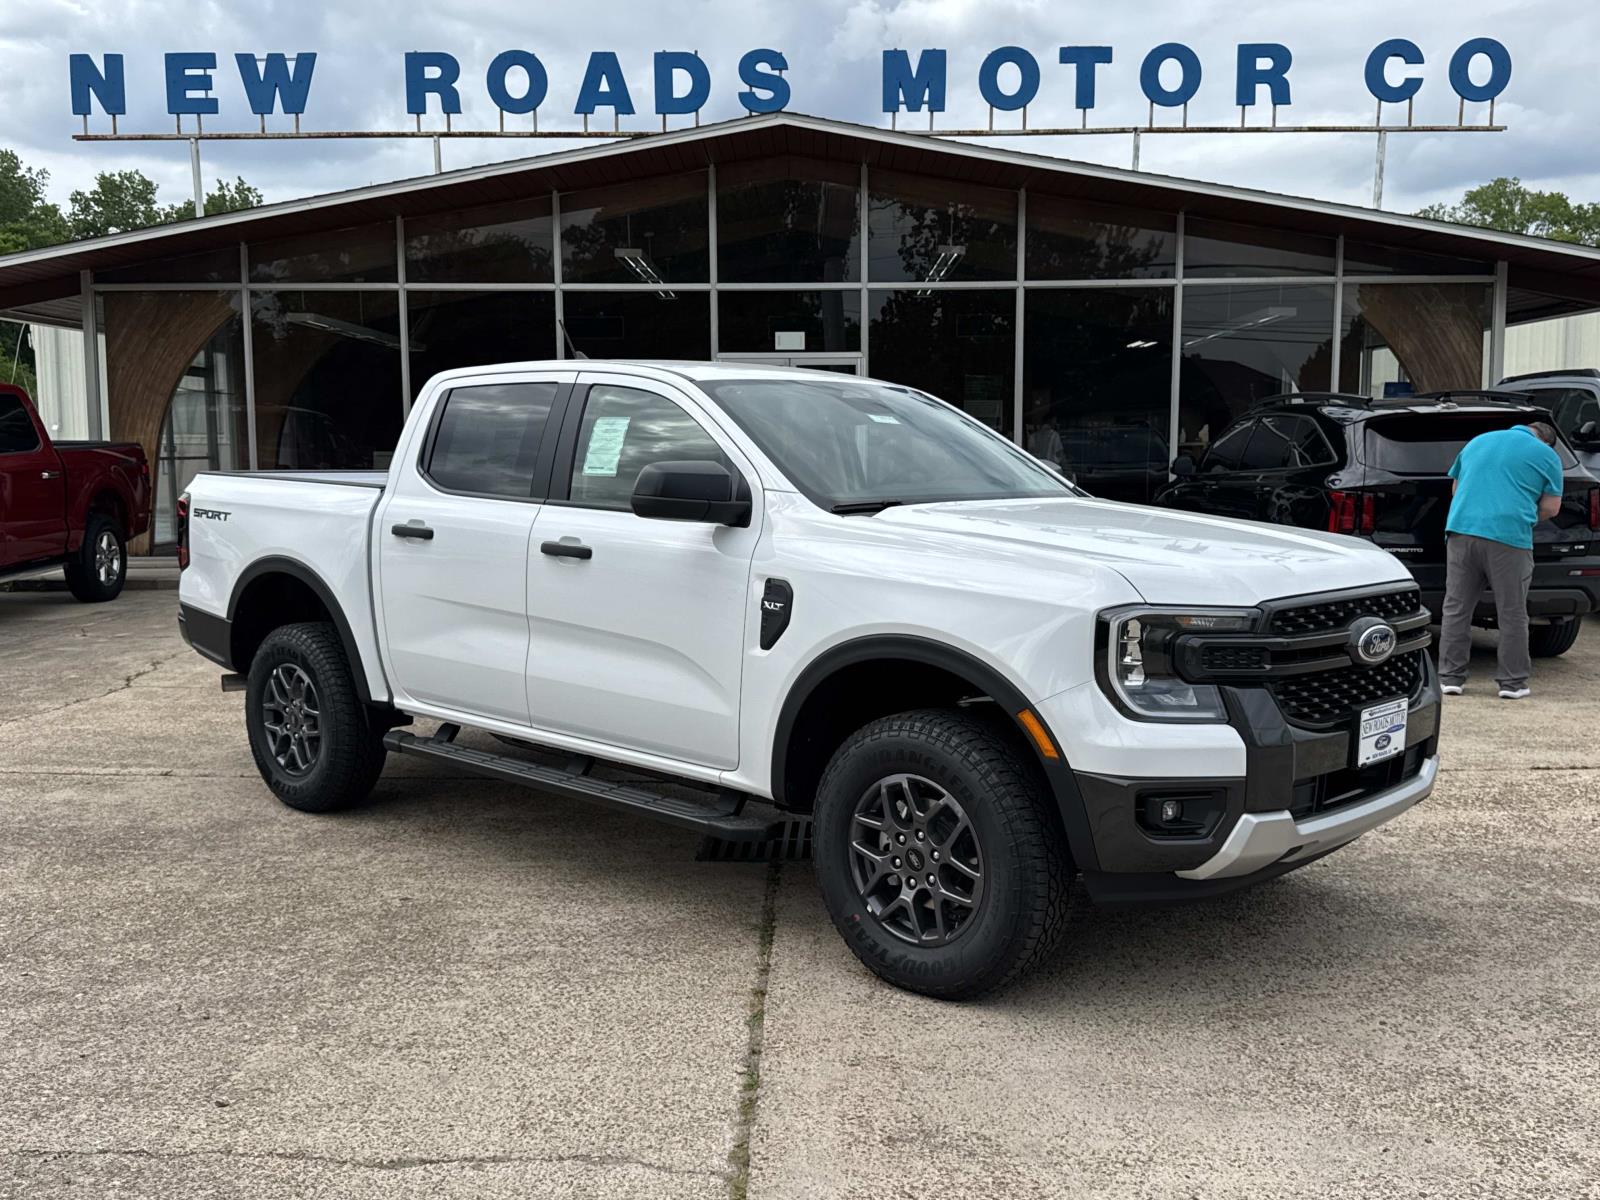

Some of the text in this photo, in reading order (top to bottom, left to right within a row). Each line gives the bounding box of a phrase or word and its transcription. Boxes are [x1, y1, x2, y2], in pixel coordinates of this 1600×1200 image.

[69, 38, 1512, 115] NEW ROADS MOTOR CO
[193, 507, 232, 521] SPORT
[763, 600, 785, 611] XLT
[1369, 633, 1391, 655] Ford
